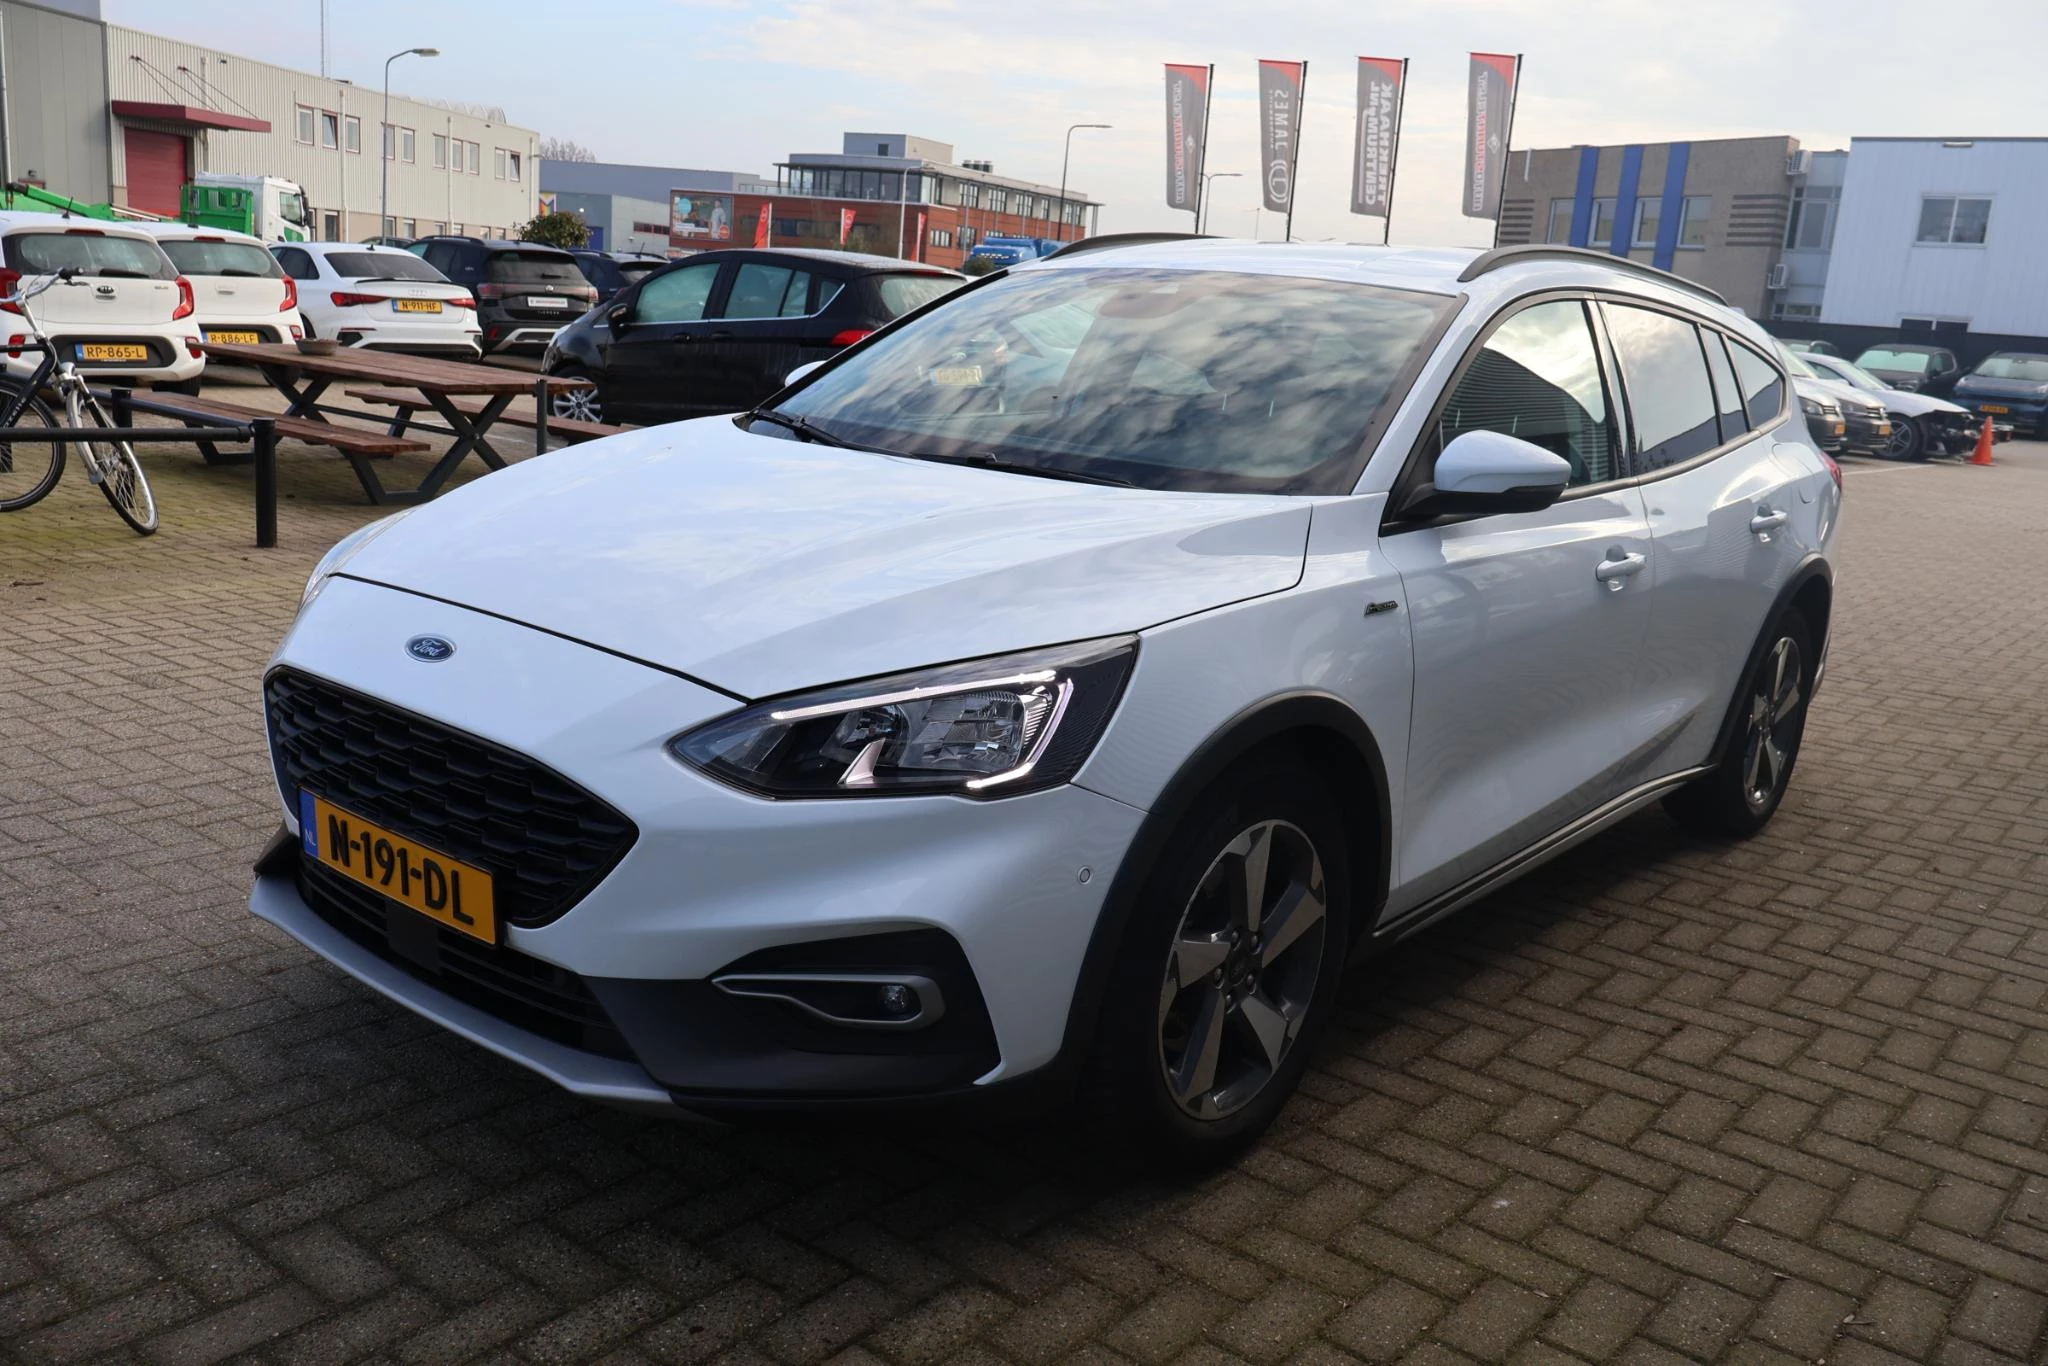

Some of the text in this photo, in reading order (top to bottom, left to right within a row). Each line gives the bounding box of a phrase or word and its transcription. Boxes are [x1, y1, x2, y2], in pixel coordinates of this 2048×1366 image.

[402, 300, 437, 311] N-911-HF
[87, 345, 142, 358] RP-865-L
[413, 637, 441, 657] Ford
[304, 829, 316, 848] NL
[327, 813, 475, 926] N-191-DL
